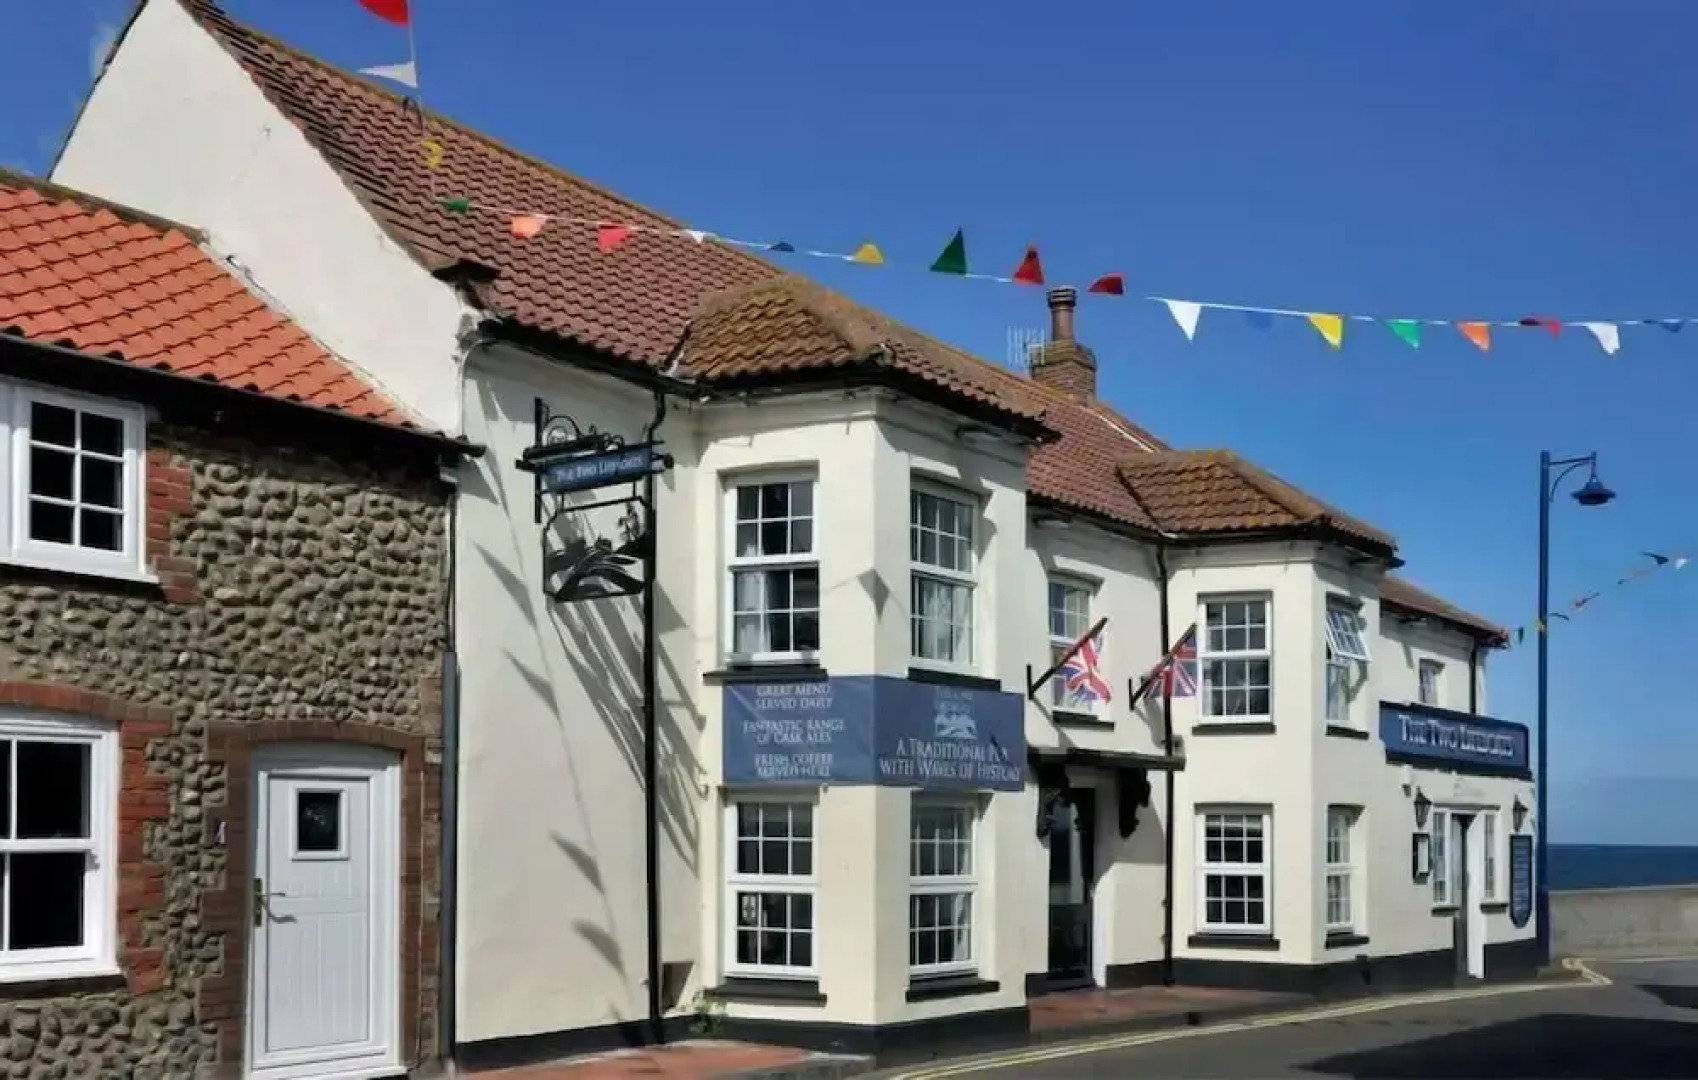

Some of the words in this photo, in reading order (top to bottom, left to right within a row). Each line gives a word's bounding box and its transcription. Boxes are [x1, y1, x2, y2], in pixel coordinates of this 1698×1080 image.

[1427, 719, 1458, 749] TWO
[896, 736, 906, 756] A
[909, 738, 985, 762] TRADITIONAL
[880, 758, 915, 776] WITH
